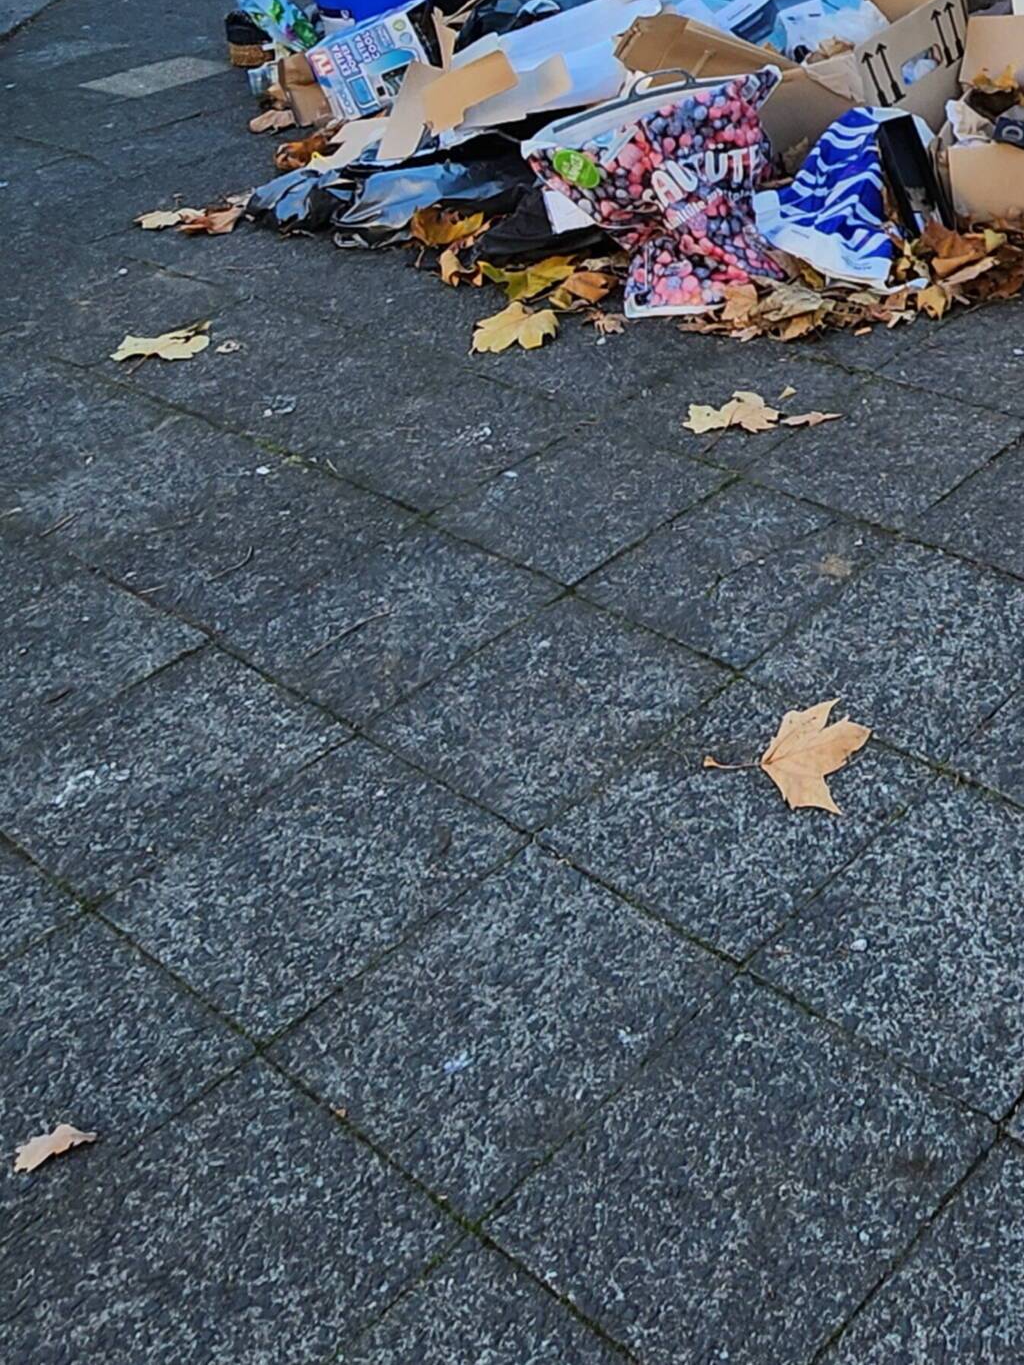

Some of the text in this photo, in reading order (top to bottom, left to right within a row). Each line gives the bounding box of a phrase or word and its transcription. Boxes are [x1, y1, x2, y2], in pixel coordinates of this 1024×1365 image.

[341, 44, 360, 73] POWER
[354, 34, 373, 63] EXTRA
[362, 31, 380, 60] COOL
[331, 44, 352, 77] EXTRA
